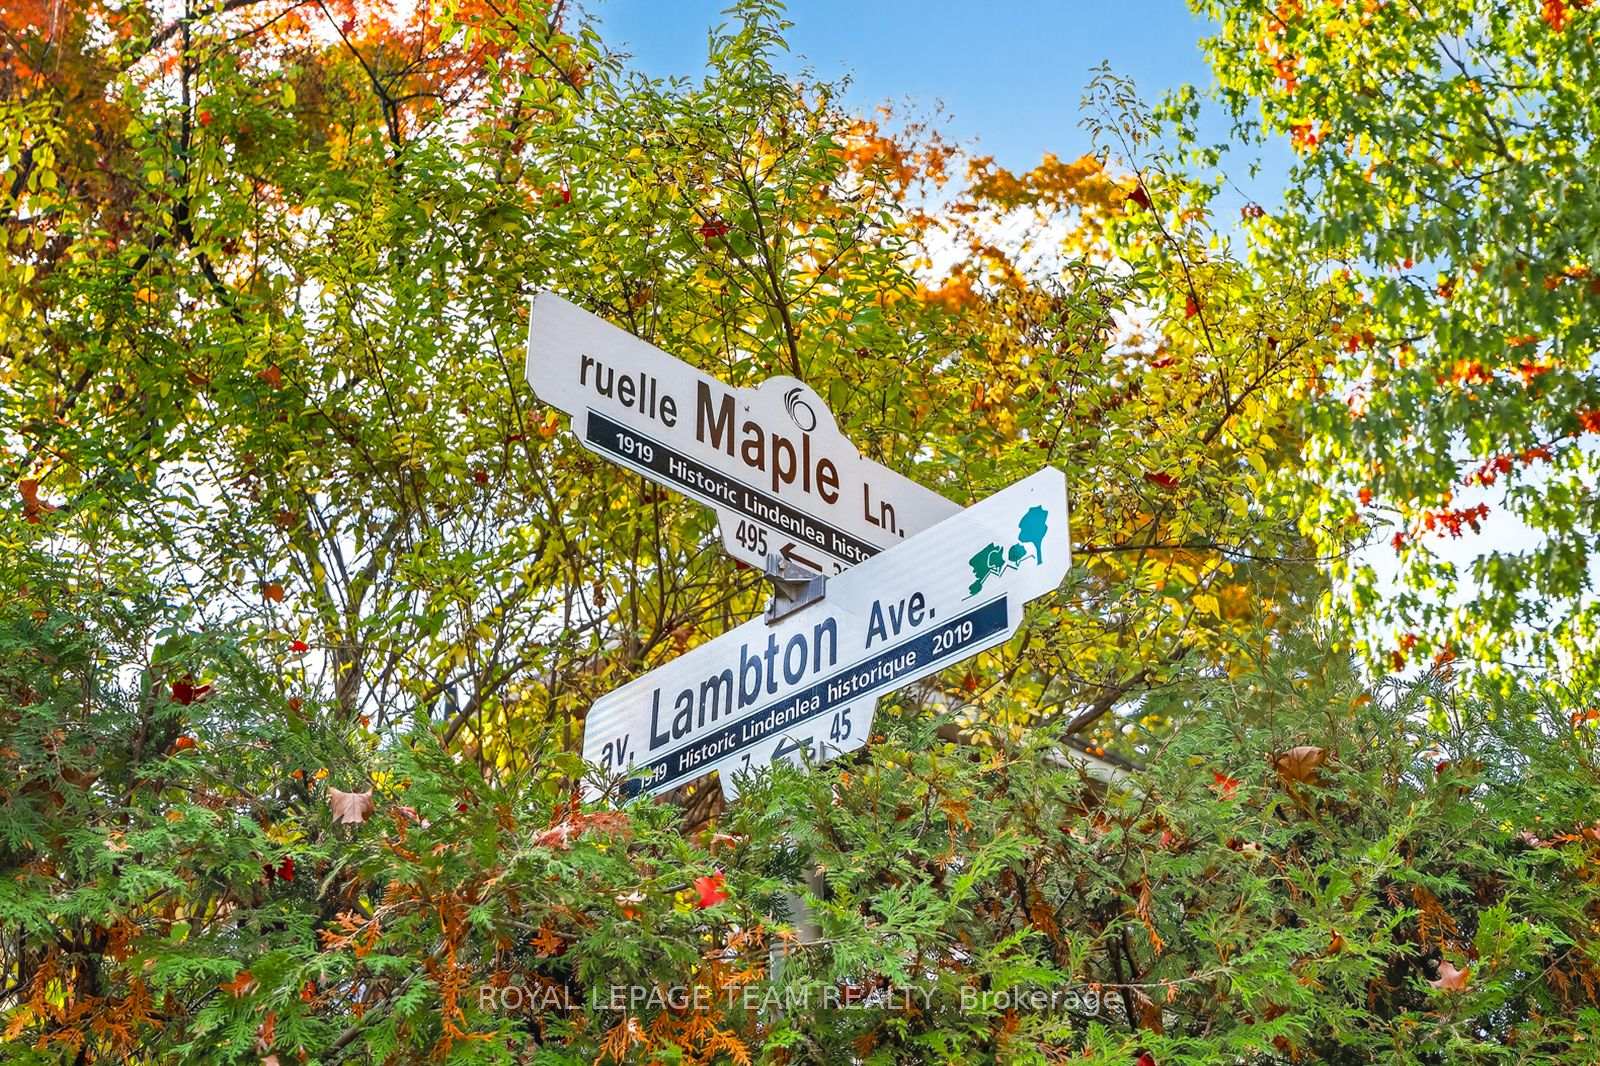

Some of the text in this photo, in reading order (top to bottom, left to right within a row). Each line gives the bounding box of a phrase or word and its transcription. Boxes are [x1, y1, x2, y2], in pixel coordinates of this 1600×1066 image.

[579, 354, 905, 538] ruelle Maple Ln.
[616, 432, 654, 463] 1919
[669, 457, 737, 504] Historic
[744, 492, 826, 545] Lindenlea
[735, 519, 768, 557] 495
[650, 616, 838, 751] Lambton
[865, 591, 936, 649] Ave.
[679, 732, 736, 771] Historic
[741, 694, 820, 742] Lindenlea
[827, 651, 917, 702] historique
[932, 621, 973, 655] 2019
[830, 707, 852, 743] 45
